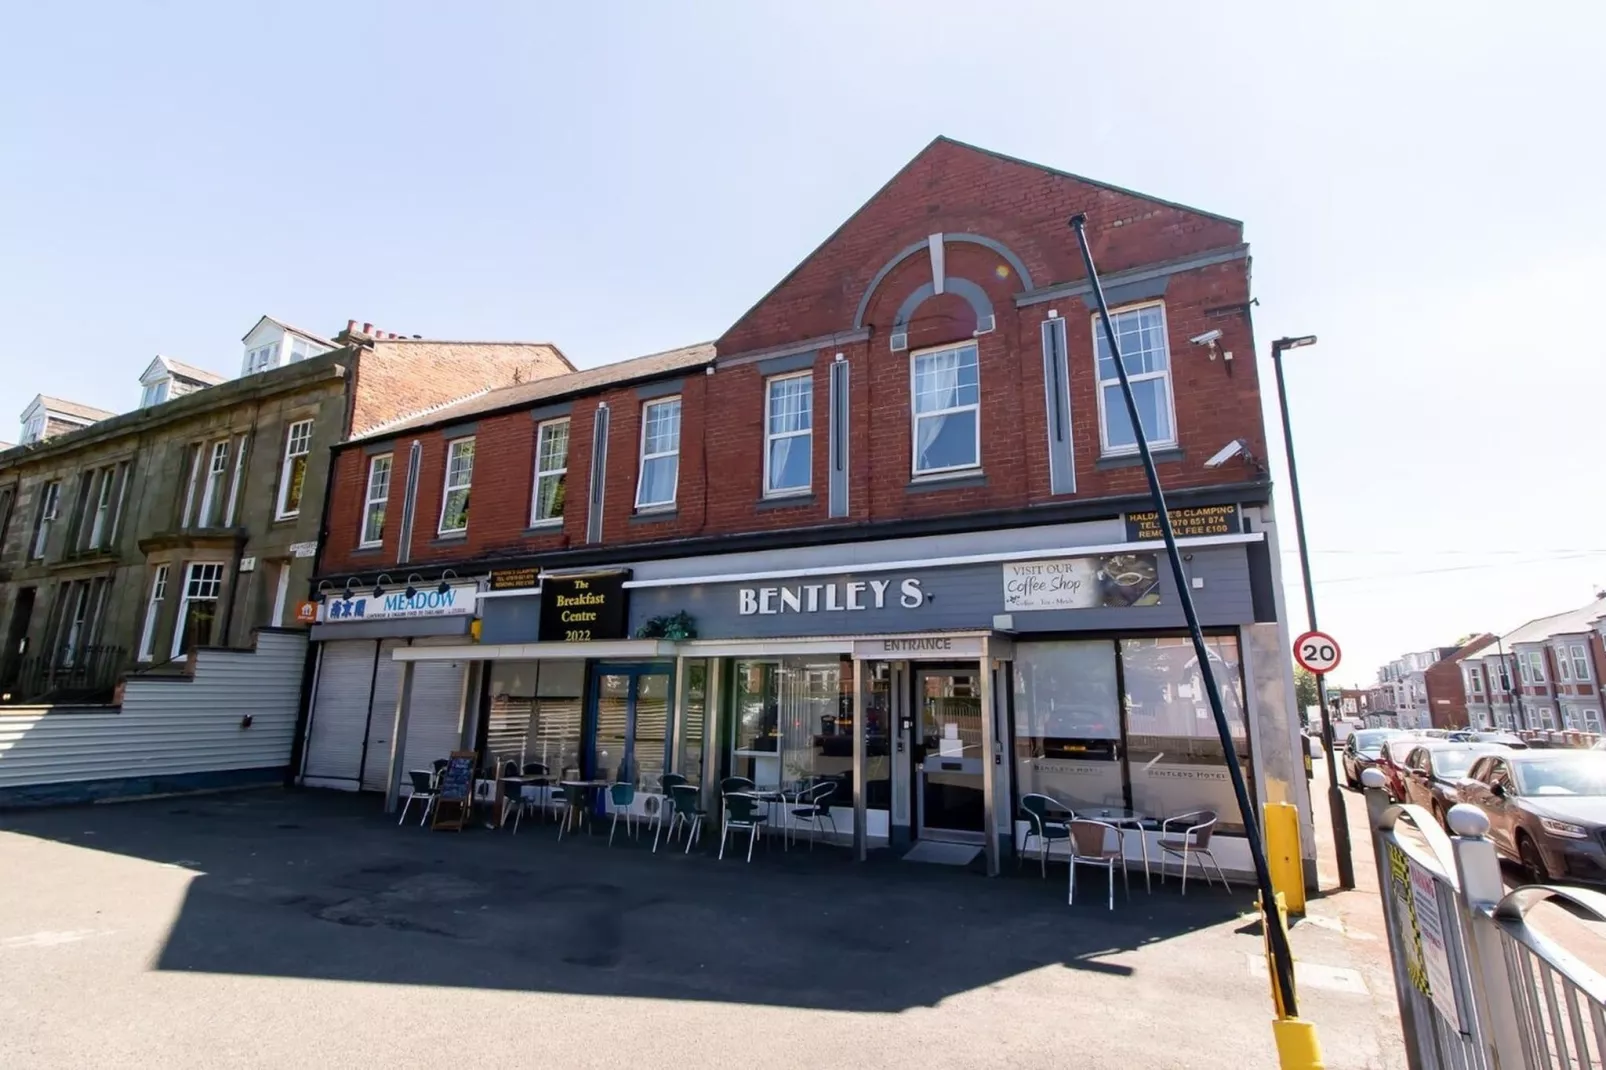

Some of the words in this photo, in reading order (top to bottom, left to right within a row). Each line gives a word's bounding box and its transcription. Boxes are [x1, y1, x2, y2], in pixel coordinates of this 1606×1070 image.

[1129, 510, 1182, 521] HALDAE'S
[1183, 505, 1235, 517] CLAMPING
[1185, 526, 1205, 535] FEE
[1206, 524, 1228, 534] £100
[1013, 564, 1044, 575] VISIT
[1046, 563, 1073, 574] OUR
[574, 579, 589, 590] The
[1007, 575, 1048, 597] Coffee
[1048, 574, 1081, 594] Shop
[383, 589, 457, 611] MEADOW
[556, 592, 605, 607] Breakfast
[561, 610, 597, 622] Centre
[565, 629, 591, 642] 2022
[884, 638, 952, 652] ENTRANCE
[1303, 644, 1335, 662] 20
